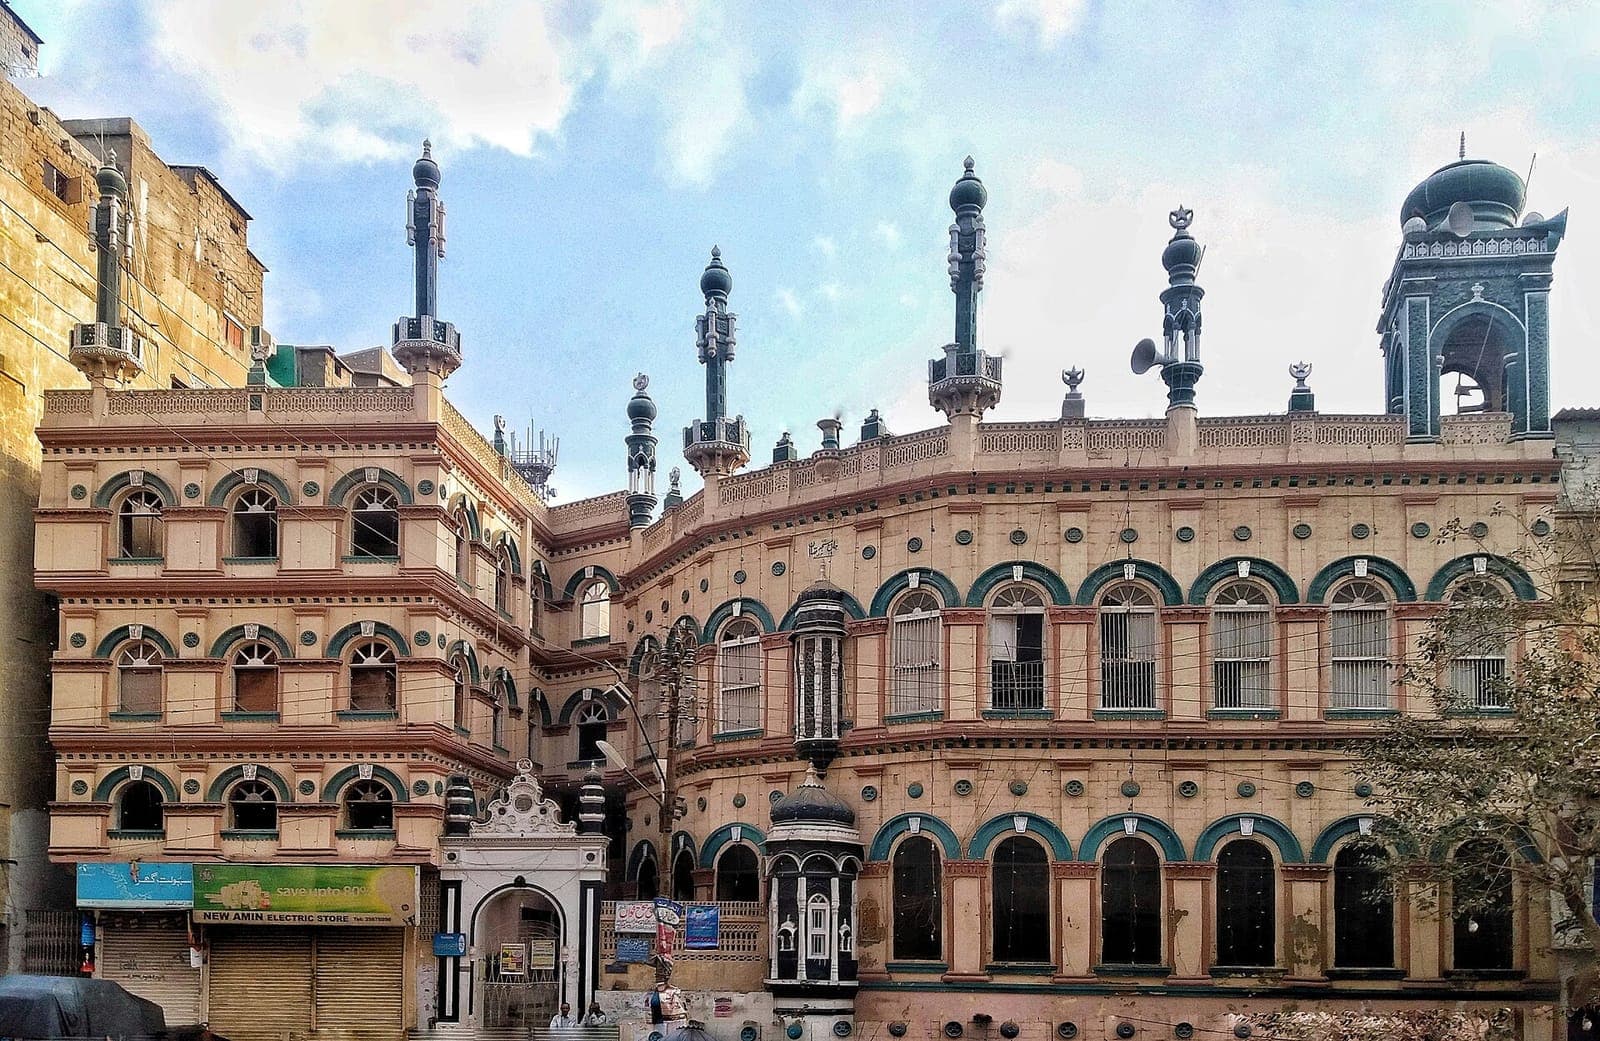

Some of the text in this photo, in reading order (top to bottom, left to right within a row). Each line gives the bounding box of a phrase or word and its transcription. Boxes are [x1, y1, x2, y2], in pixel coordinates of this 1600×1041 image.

[276, 887, 306, 897] save
[203, 911, 230, 921] NEW
[233, 911, 264, 922] AMIN
[267, 913, 315, 922] ELECTRIC
[317, 914, 350, 923] STORE
